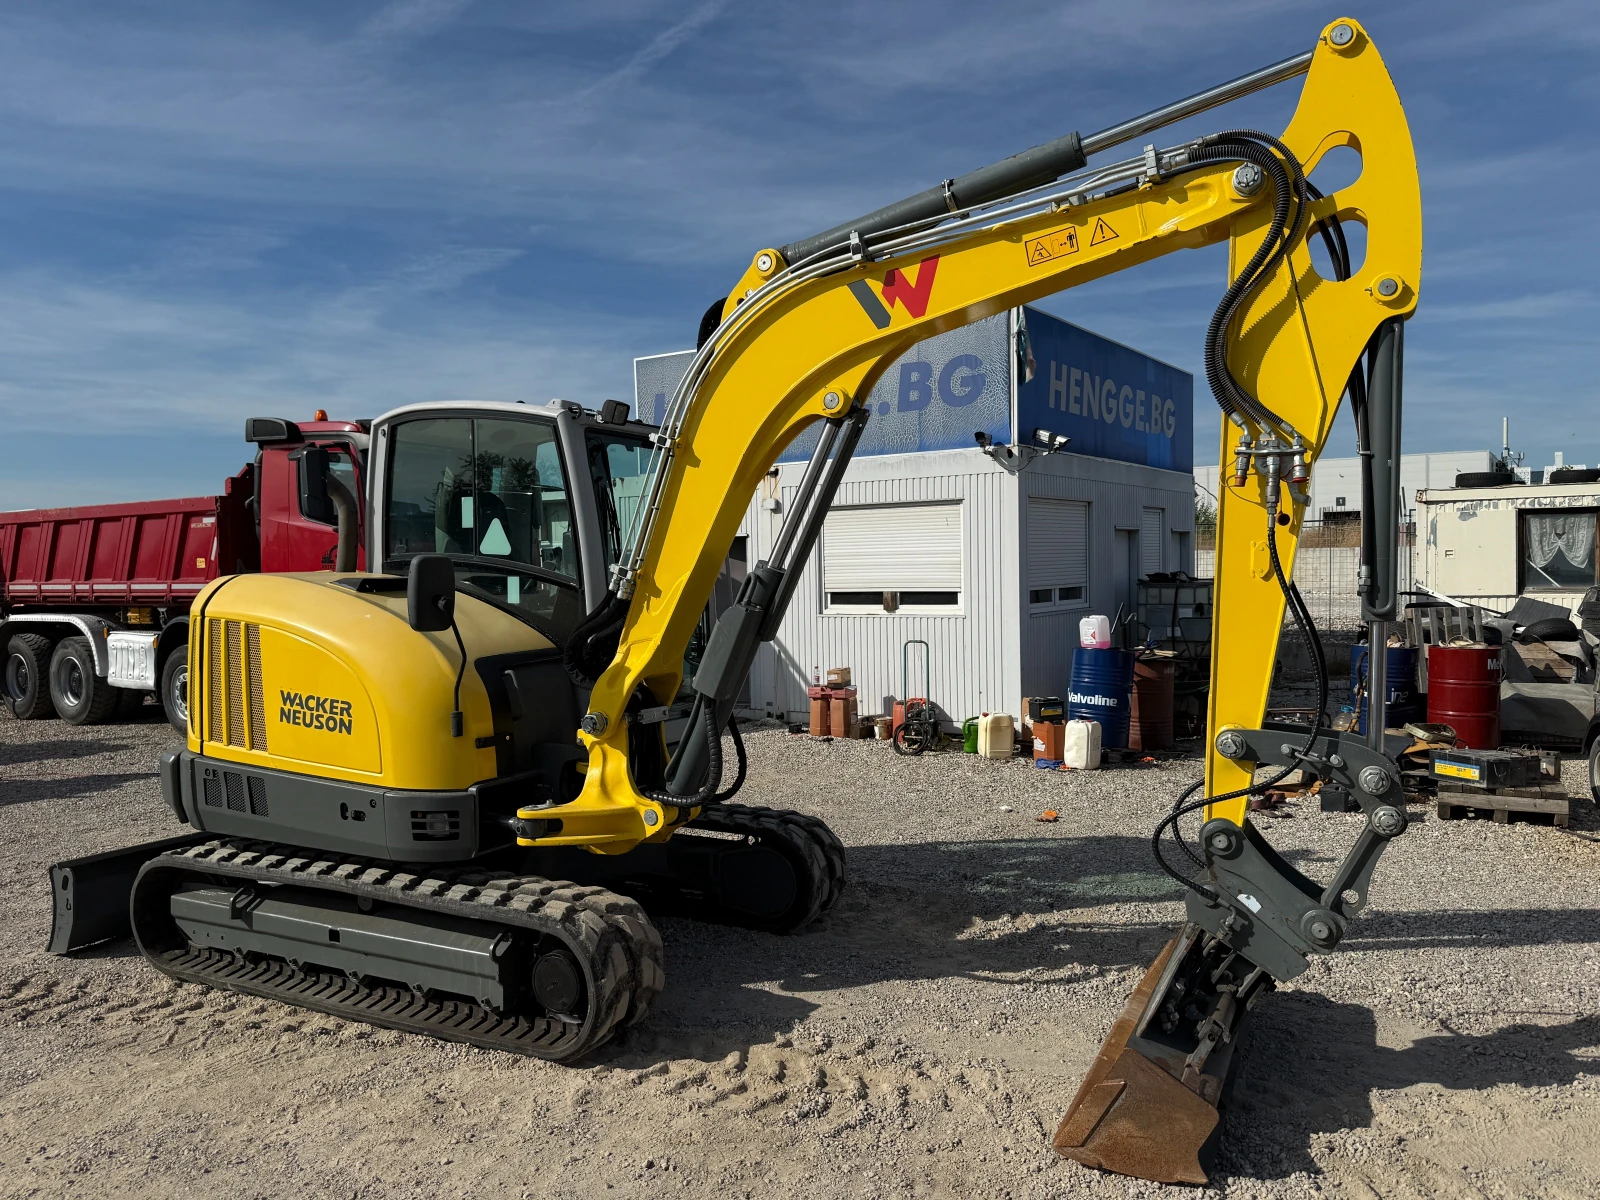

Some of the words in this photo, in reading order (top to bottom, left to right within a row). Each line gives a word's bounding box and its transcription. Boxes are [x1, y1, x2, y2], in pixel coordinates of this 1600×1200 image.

[1050, 360, 1176, 438] HENGGE.BG
[280, 690, 353, 718] WACKER
[1068, 691, 1118, 707] Valvoline
[280, 707, 353, 735] NEUSON
